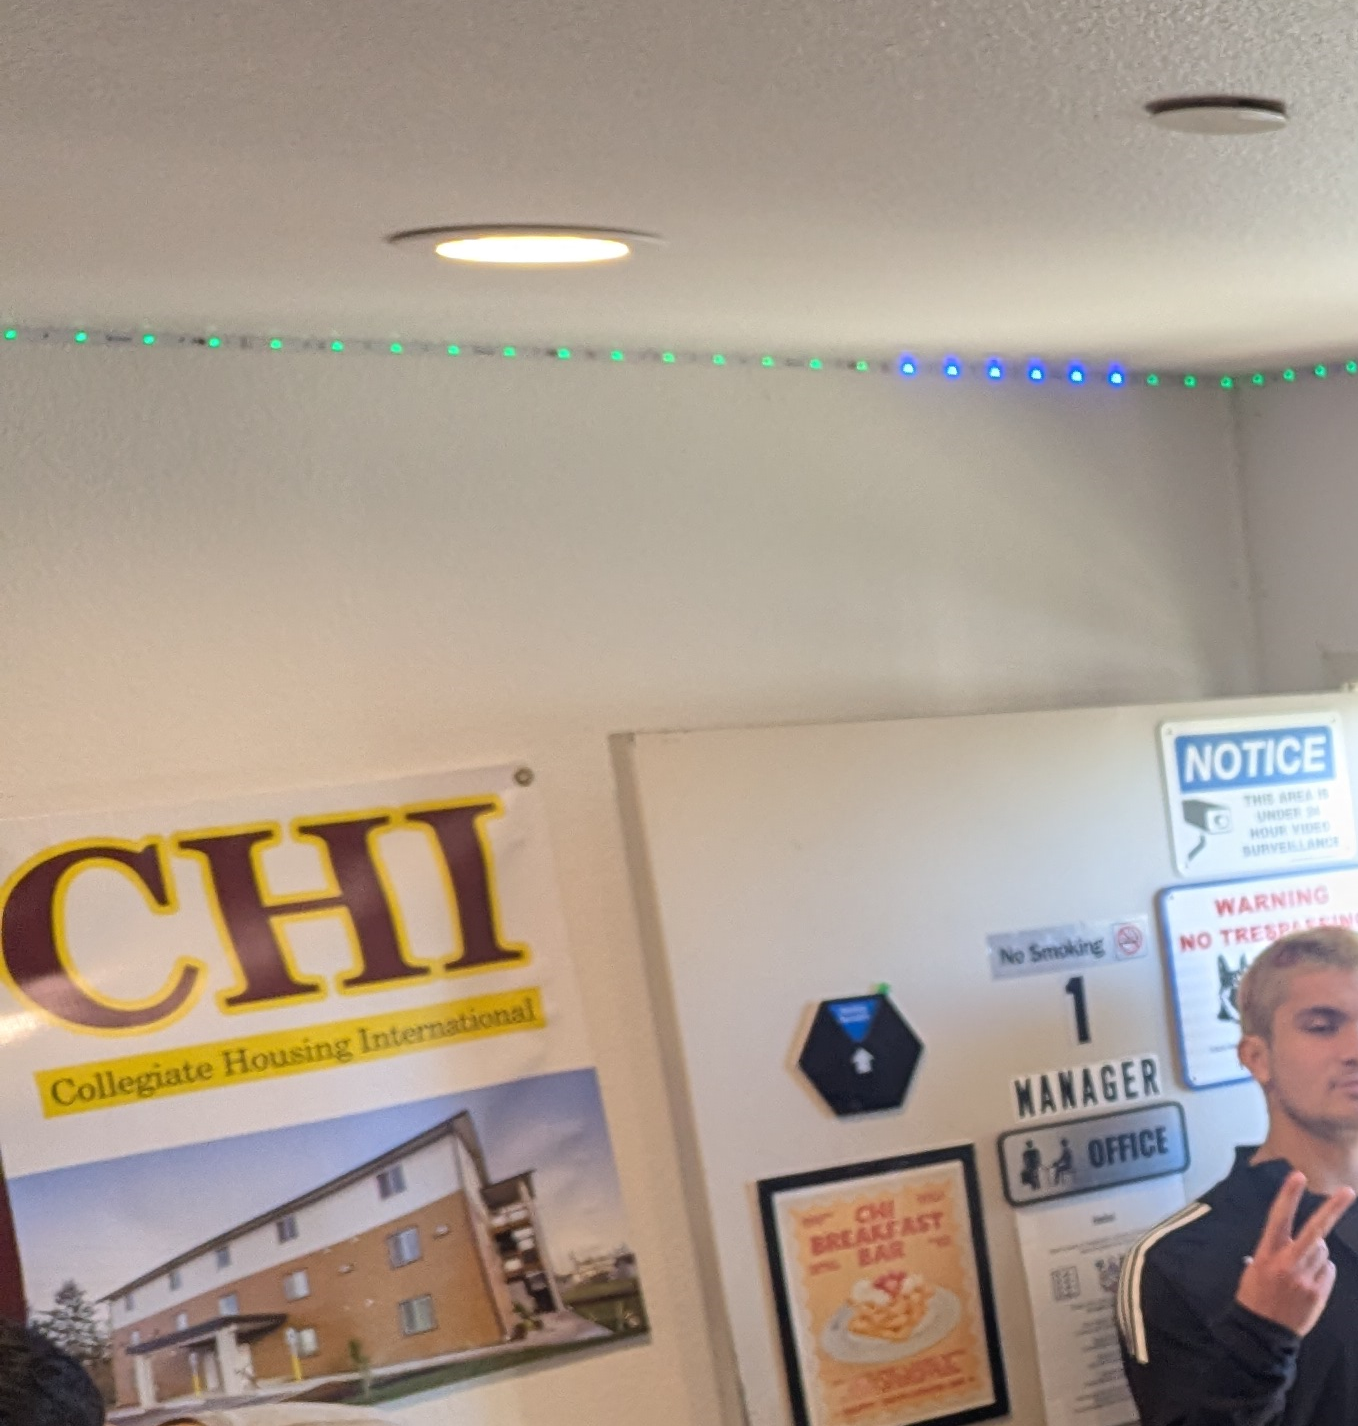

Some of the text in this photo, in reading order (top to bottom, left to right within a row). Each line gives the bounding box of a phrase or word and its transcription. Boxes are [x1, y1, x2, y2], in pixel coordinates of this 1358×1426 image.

[1184, 734, 1327, 783] NOTICE
[1243, 787, 1330, 808] THIS AREA IS
[1257, 807, 1302, 822] UNDER
[1242, 835, 1340, 858] SURVEILLANCE
[1250, 820, 1331, 840] HOUR VIDEO
[0, 794, 531, 1038] CHI
[1214, 885, 1330, 917] WARNING
[1000, 936, 1106, 965] No Smoking
[1178, 931, 1213, 952] NO
[1064, 975, 1092, 1045] 1
[50, 998, 537, 1107] Collegiate Housing International
[1013, 1057, 1161, 1119] MANAGER
[1088, 1126, 1169, 1169] OFFICE
[809, 1211, 945, 1257] BREAKFAST
